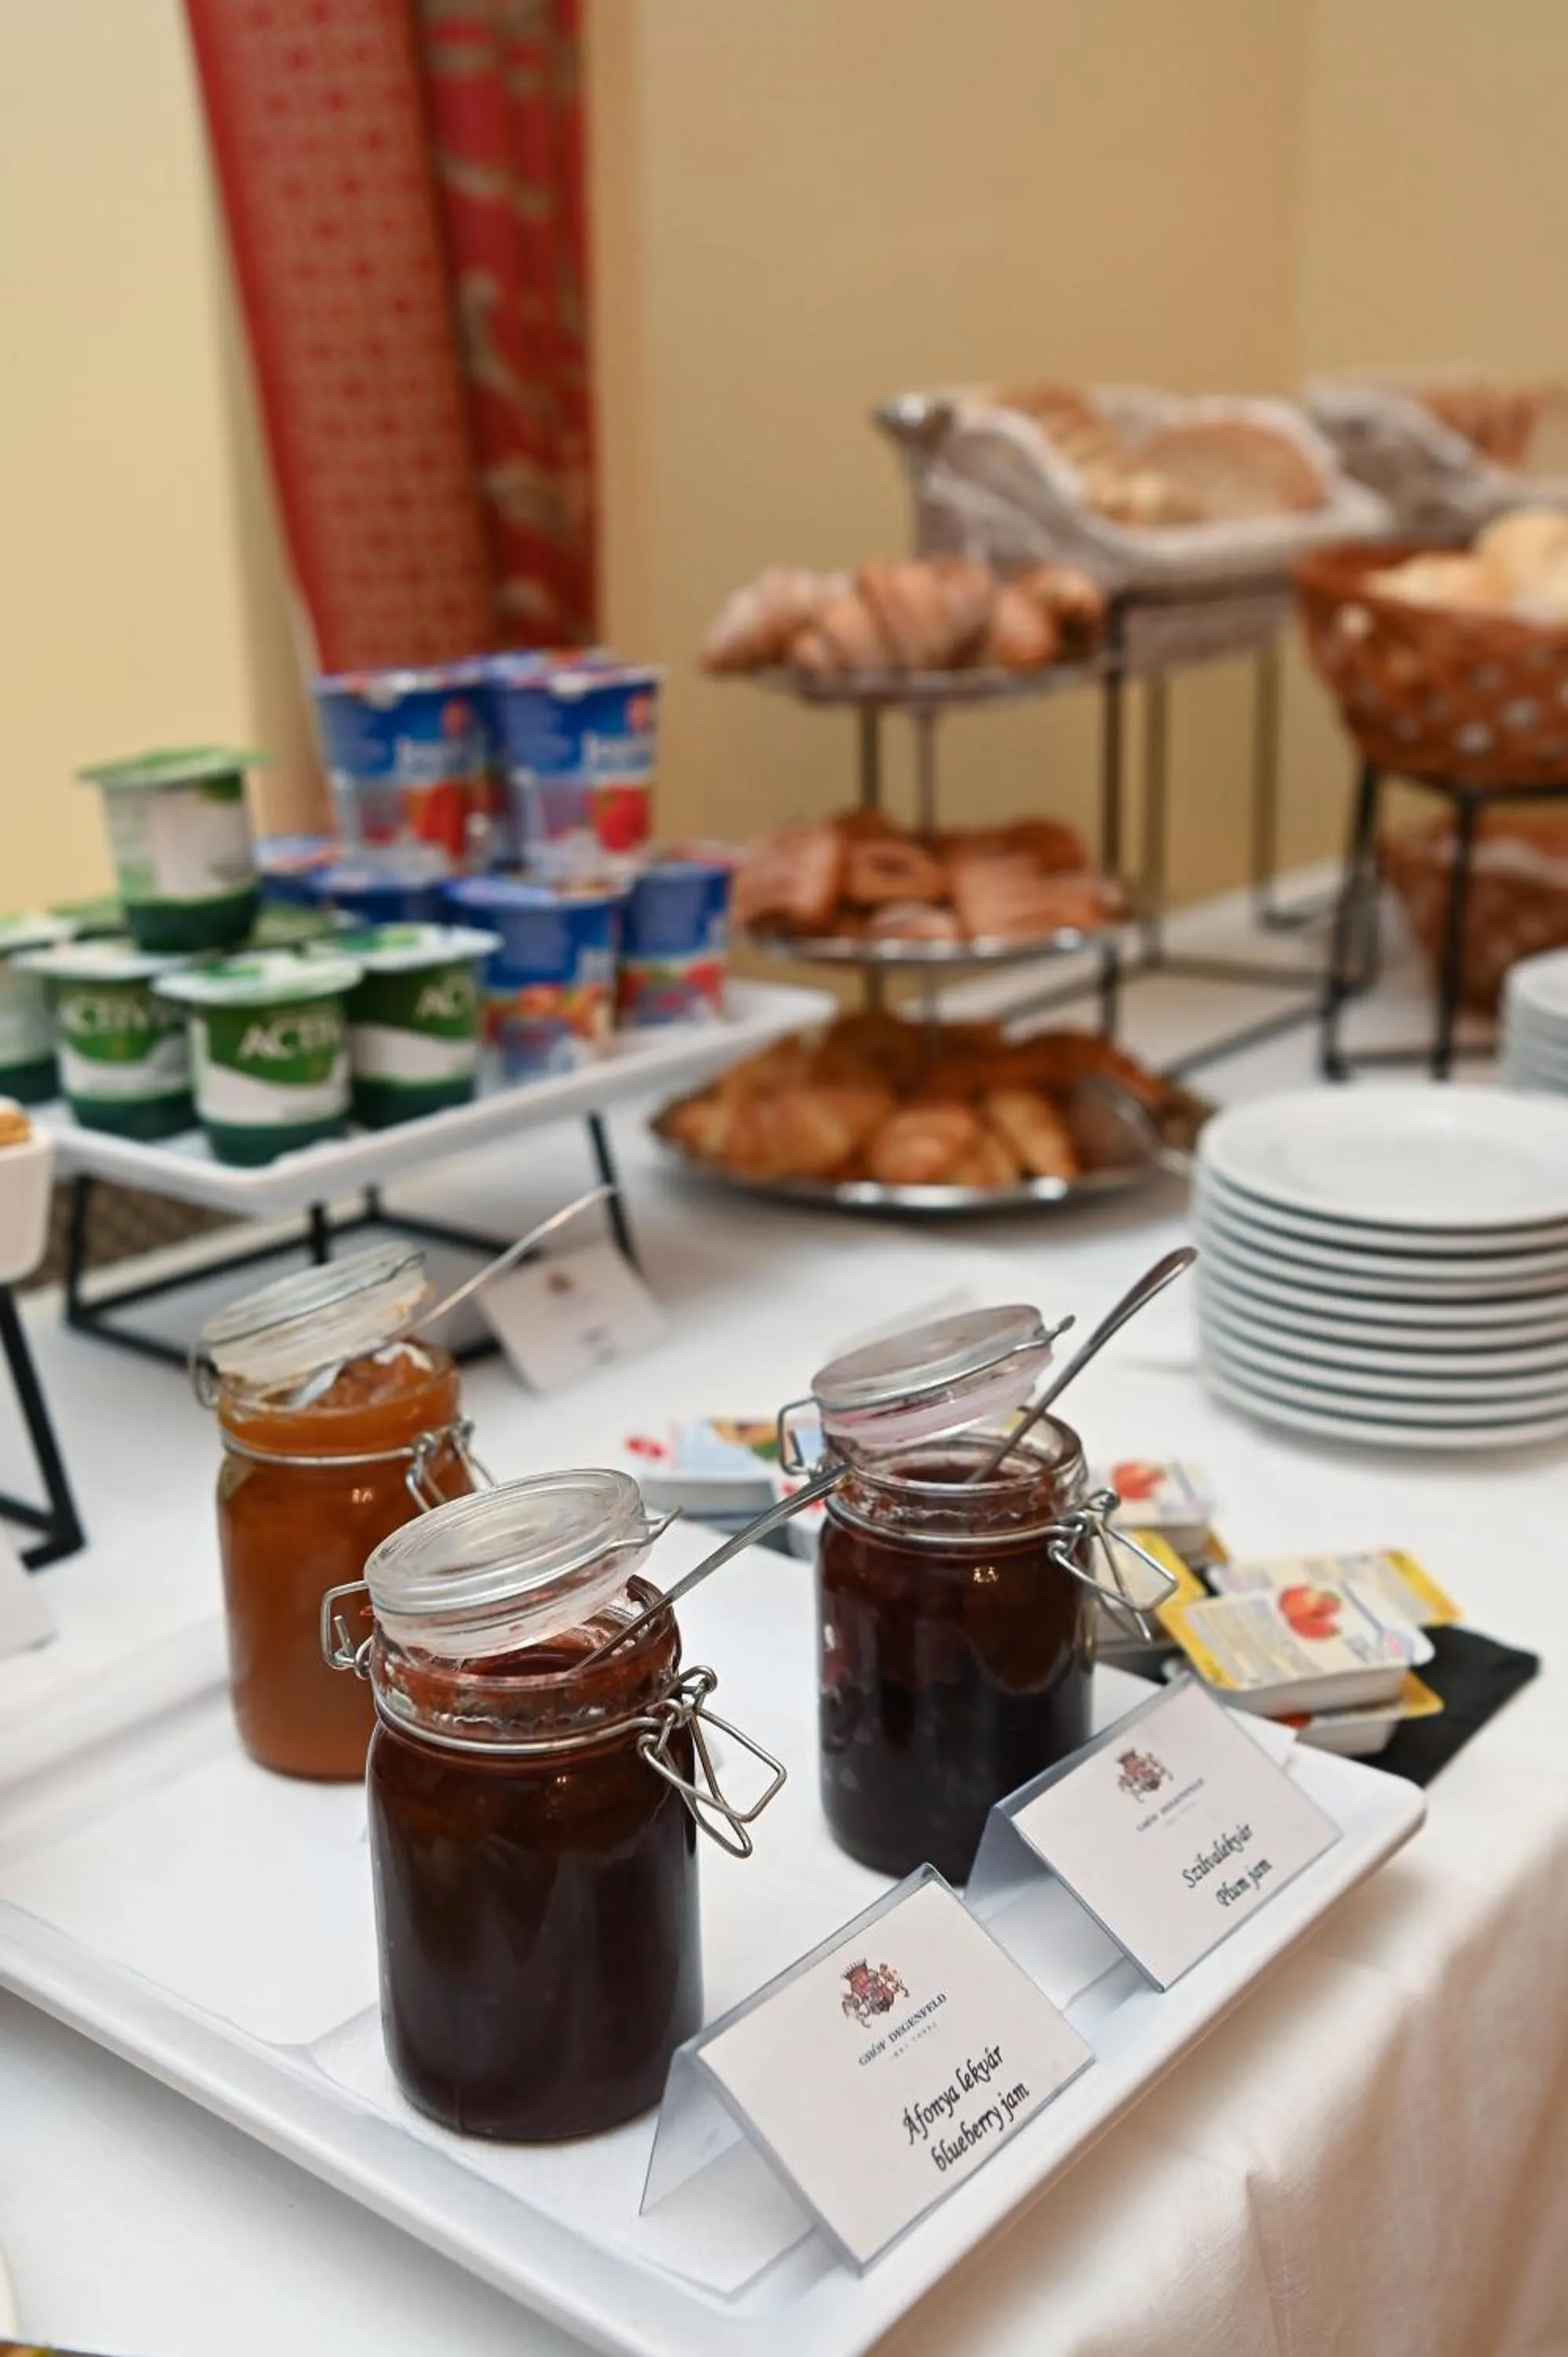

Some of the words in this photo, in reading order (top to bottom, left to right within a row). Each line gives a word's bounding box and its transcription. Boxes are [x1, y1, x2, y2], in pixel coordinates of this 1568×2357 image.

[1216, 1878, 1252, 1908] Plum
[1247, 1859, 1273, 1890] jam
[903, 2085, 961, 2146] Áfonya
[955, 2044, 1003, 2093] lekvár
[931, 2106, 1005, 2173] blueberry
[997, 2083, 1031, 2123] jam
